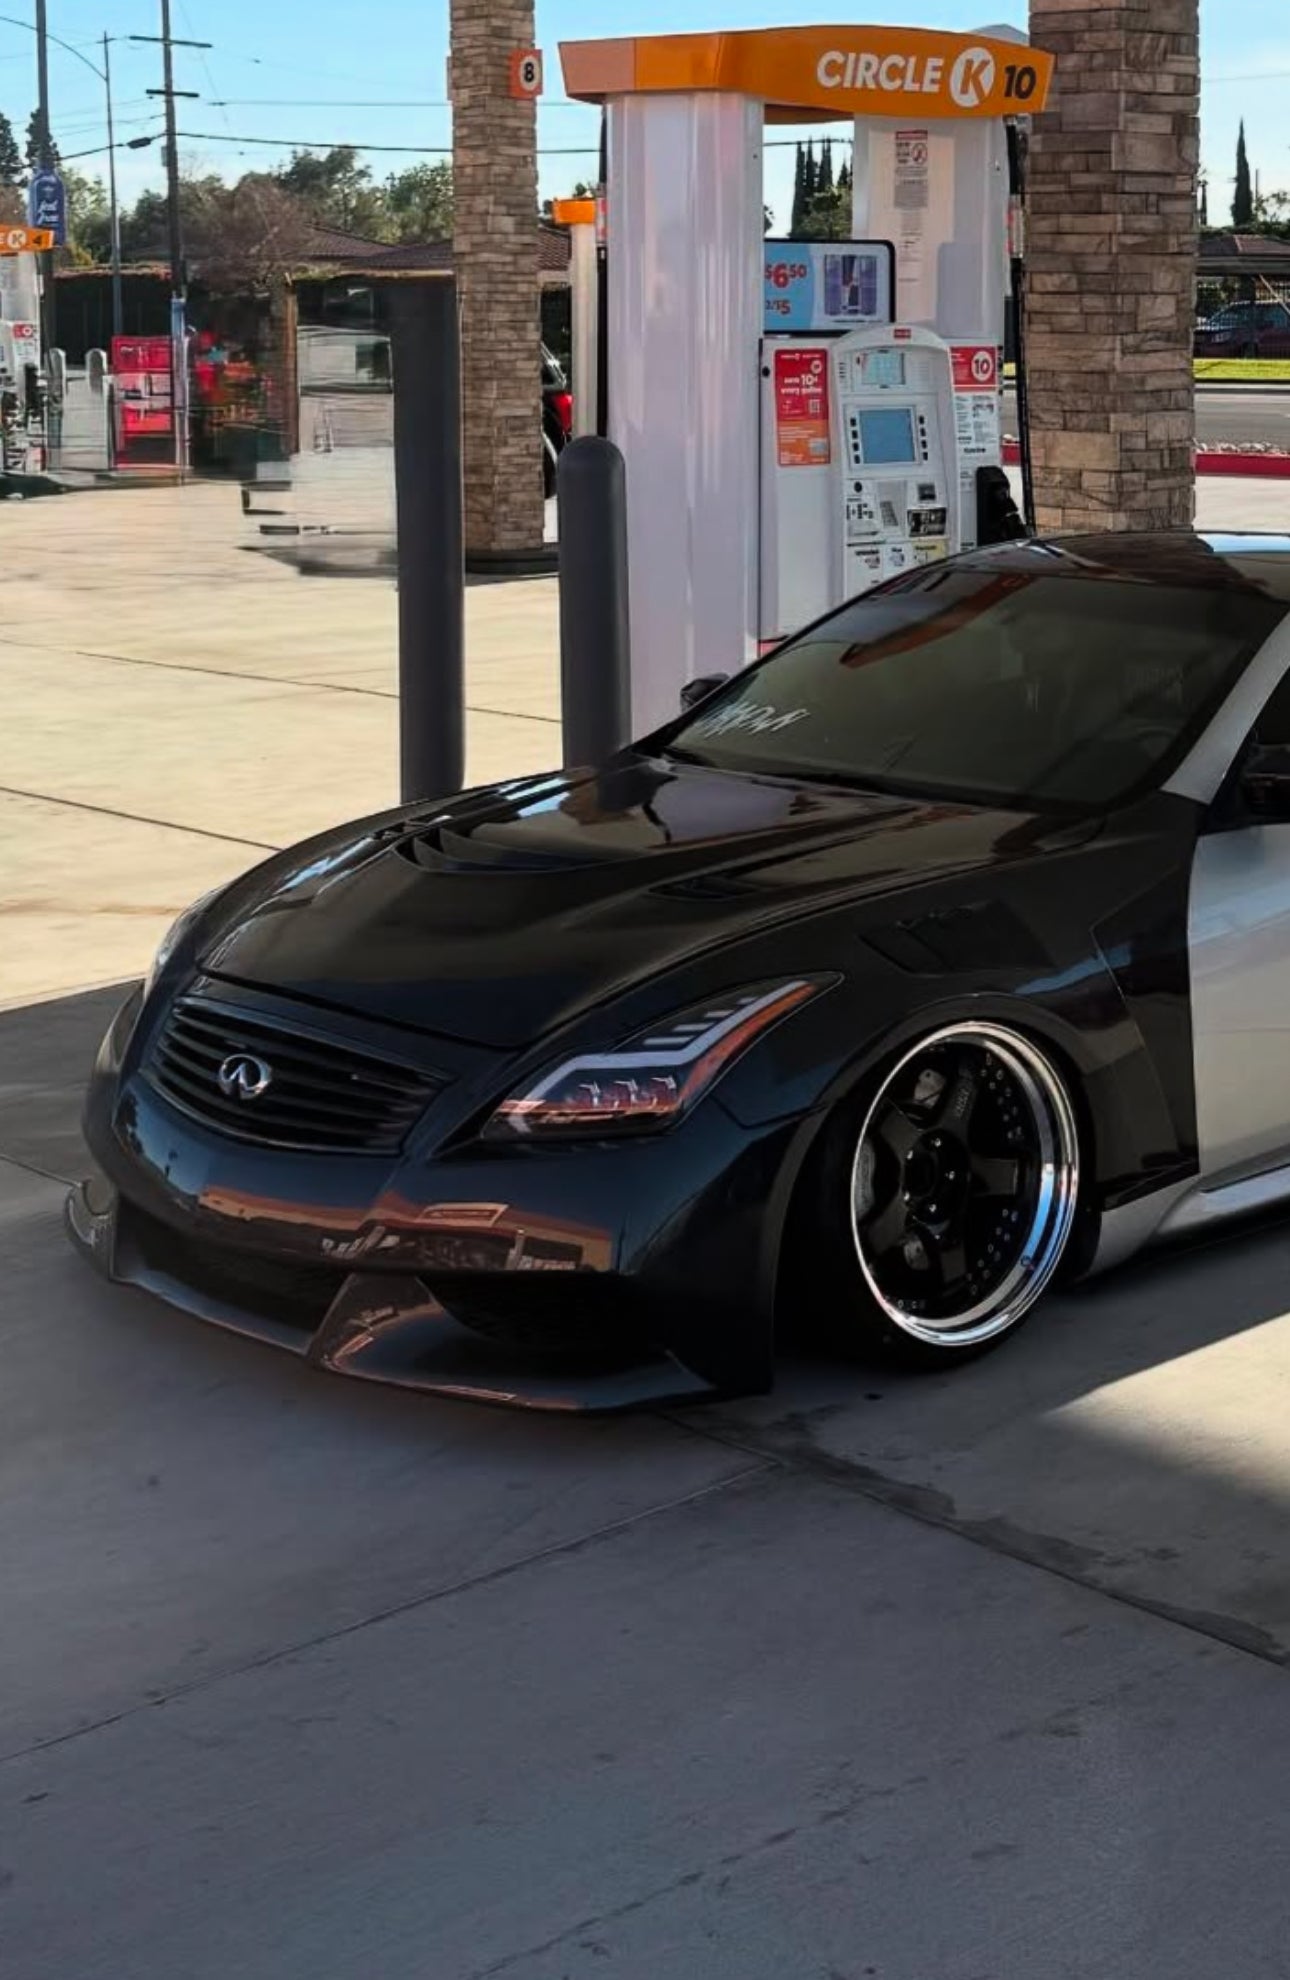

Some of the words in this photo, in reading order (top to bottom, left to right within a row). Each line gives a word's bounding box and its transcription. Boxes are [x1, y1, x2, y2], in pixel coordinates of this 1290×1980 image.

[524, 61, 535, 83] 8
[817, 50, 944, 93] CIRCLE
[957, 53, 992, 104] K
[1004, 65, 1037, 99] 10
[974, 358, 990, 375] 10
